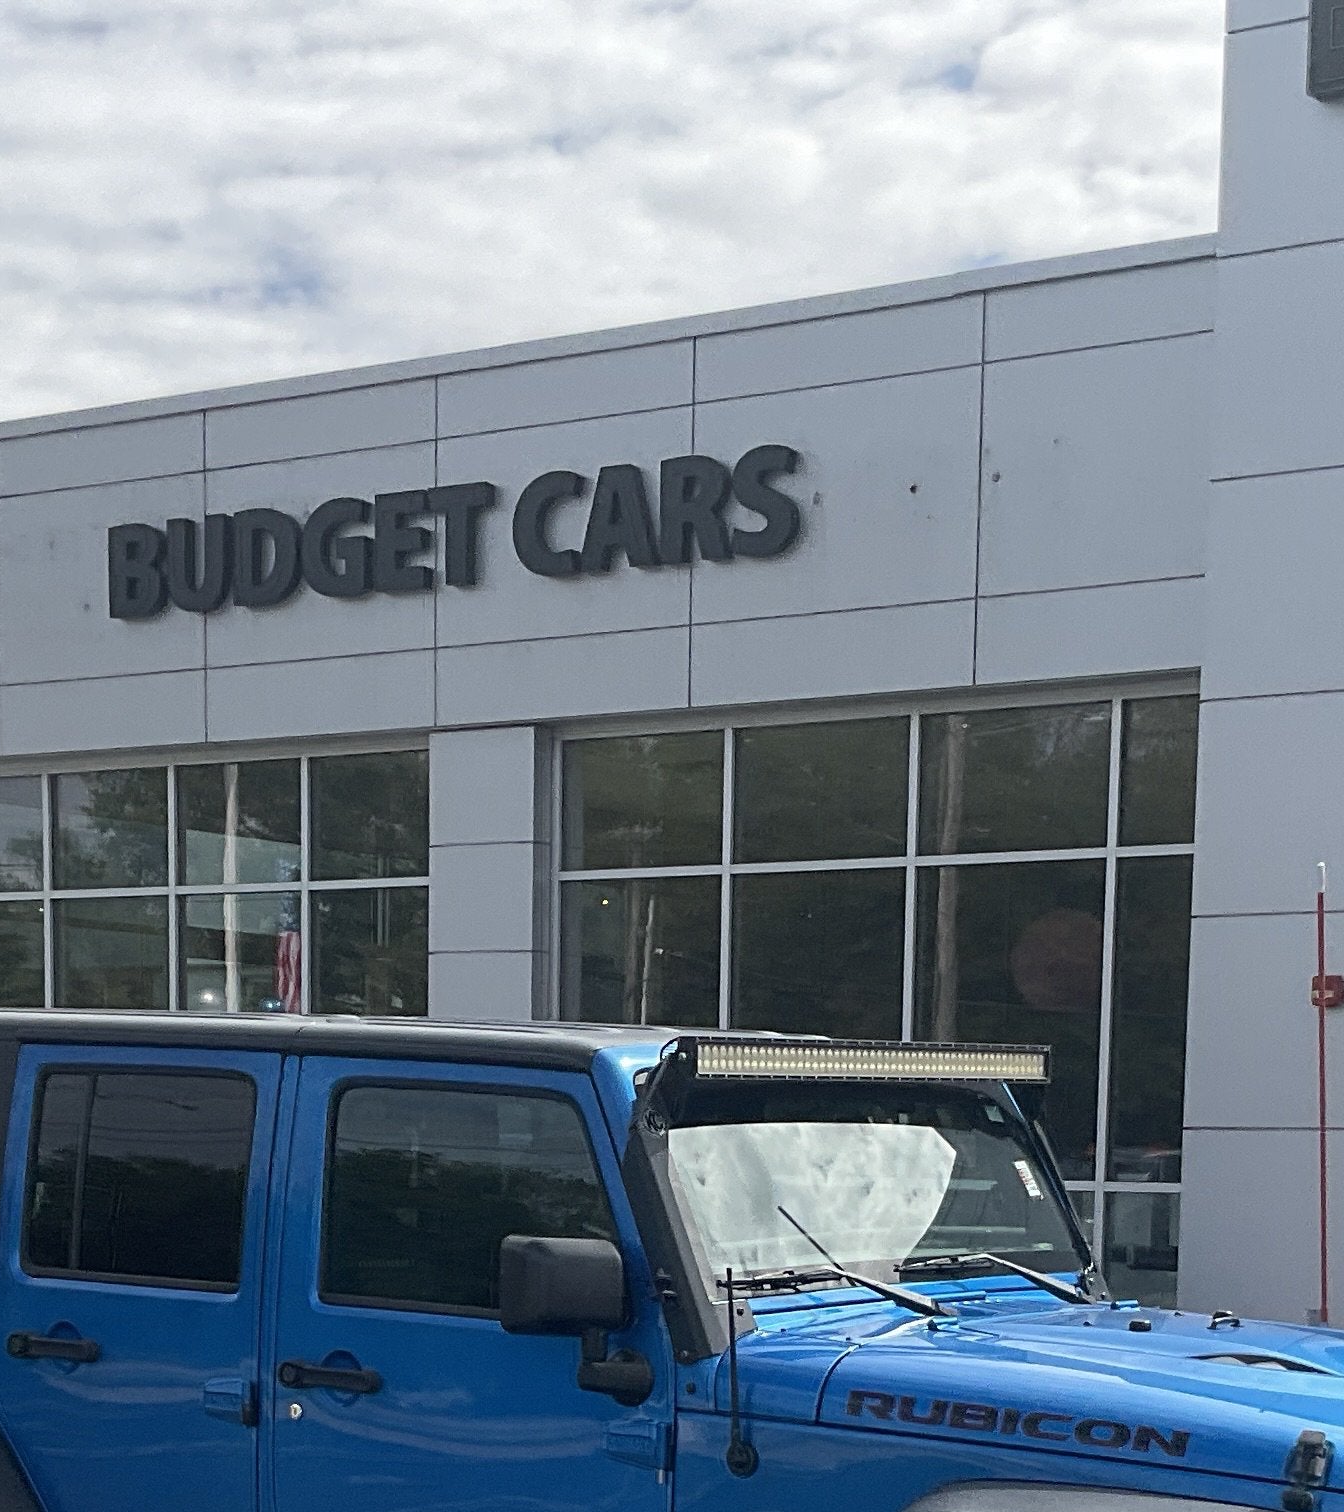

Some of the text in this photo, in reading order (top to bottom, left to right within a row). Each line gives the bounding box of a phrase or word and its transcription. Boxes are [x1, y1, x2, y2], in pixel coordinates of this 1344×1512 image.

[108, 443, 801, 620] BUDGET CARS
[846, 1389, 1191, 1458] RUBICON
